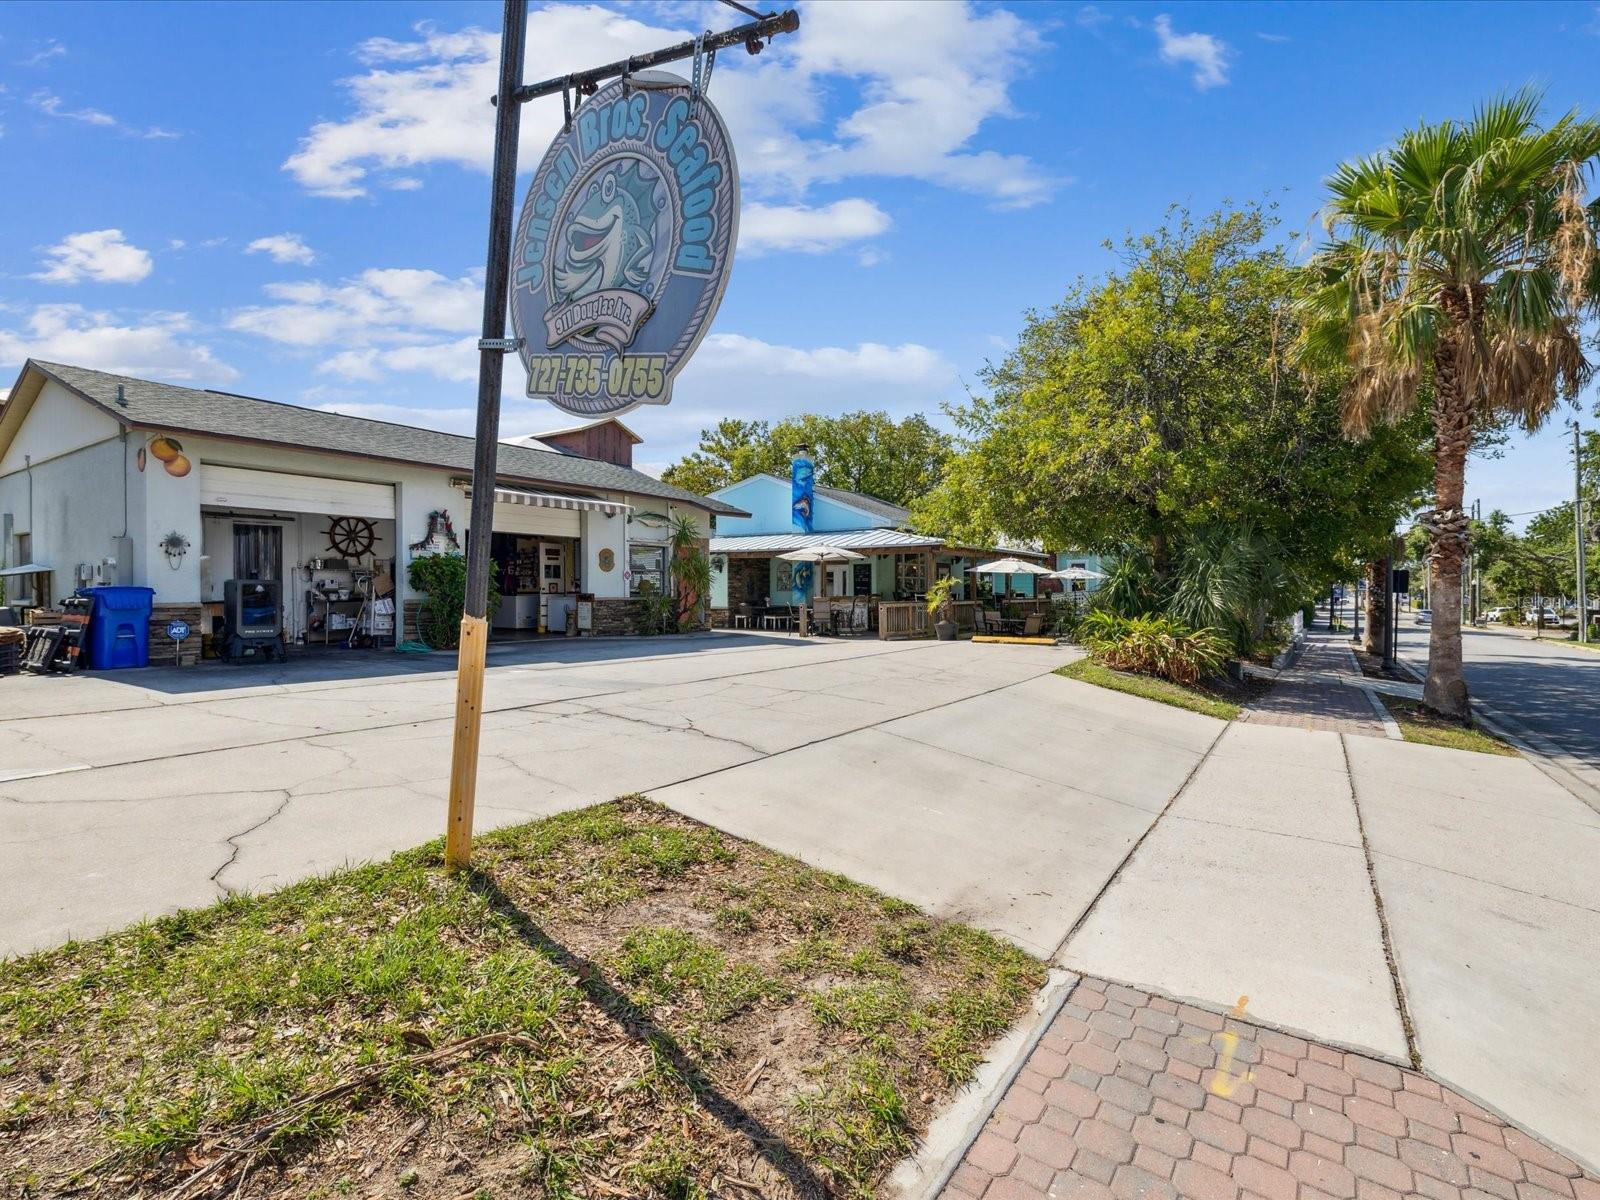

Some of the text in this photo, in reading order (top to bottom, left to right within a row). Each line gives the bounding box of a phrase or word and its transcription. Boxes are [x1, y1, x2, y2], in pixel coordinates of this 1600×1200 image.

[516, 93, 721, 287] Jensen Bros. Seafood
[555, 295, 632, 335] 911 Douglas Ave.
[528, 356, 666, 397] 727-735-0755
[171, 626, 186, 634] ADT
